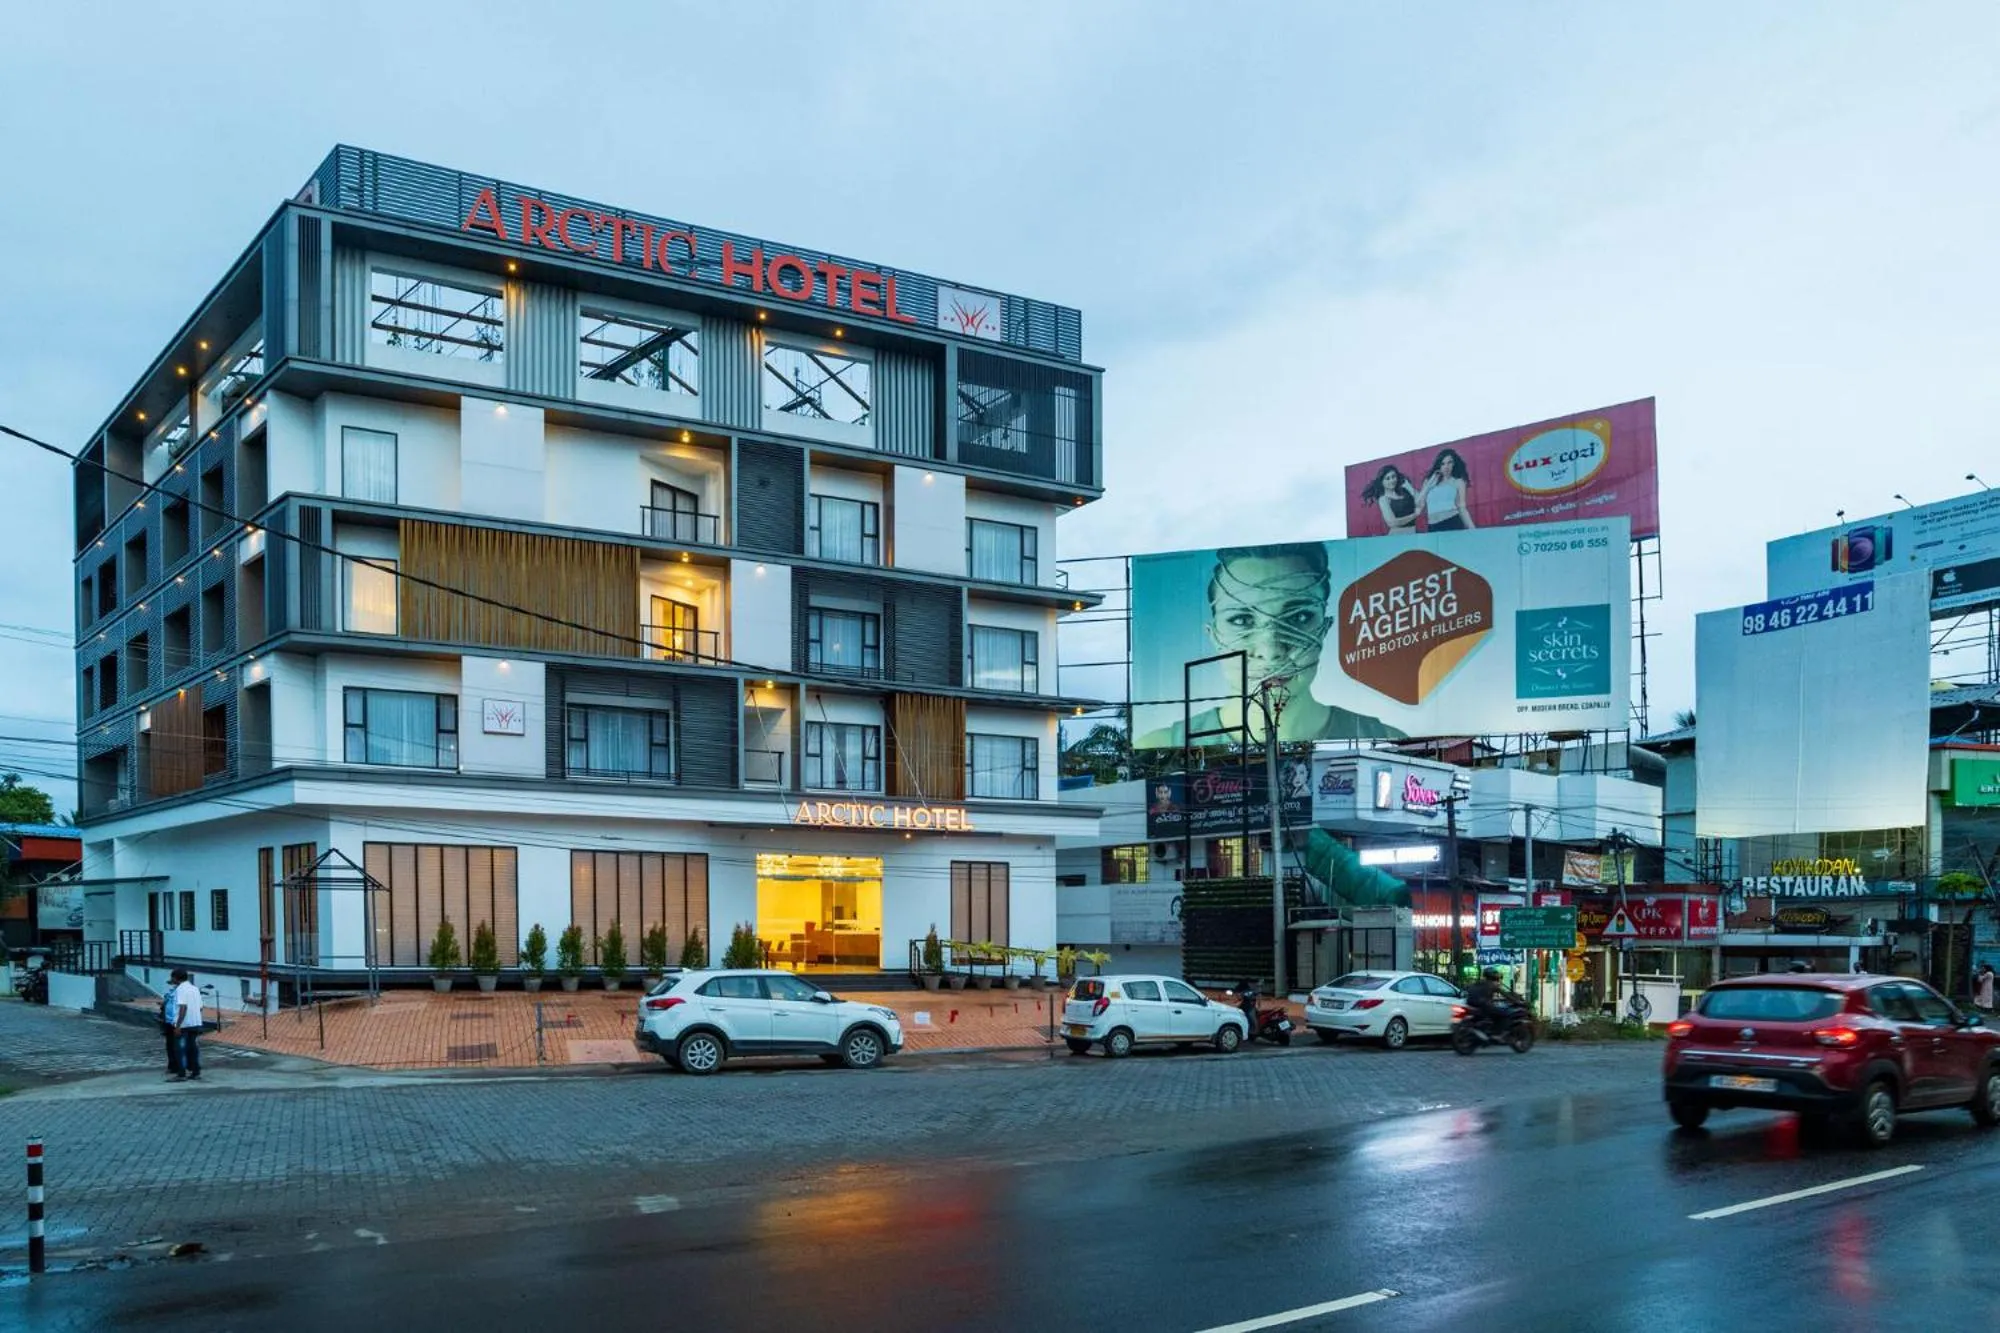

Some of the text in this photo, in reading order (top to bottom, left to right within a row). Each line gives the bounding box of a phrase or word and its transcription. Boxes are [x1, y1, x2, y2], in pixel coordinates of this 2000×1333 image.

[461, 187, 916, 323] ARCTIC HOTEL
[1533, 543, 1567, 553] 70250
[1587, 537, 1608, 548] 555
[1349, 567, 1459, 624] ARREST
[1743, 614, 1765, 634] 98
[1769, 608, 1791, 628] 46
[1796, 603, 1818, 624] 22
[1823, 597, 1847, 618] 44
[1852, 591, 1873, 613] 11
[1345, 646, 1376, 664] WITH
[1379, 632, 1420, 655] BOTOX
[1431, 611, 1482, 637] FILLERS
[1356, 593, 1458, 646] AGEING
[1528, 644, 1599, 663] secrets
[1543, 630, 1581, 648] skin
[795, 802, 974, 831] ARCTIC HOTEL
[1772, 857, 1856, 875] KOYIKODAN
